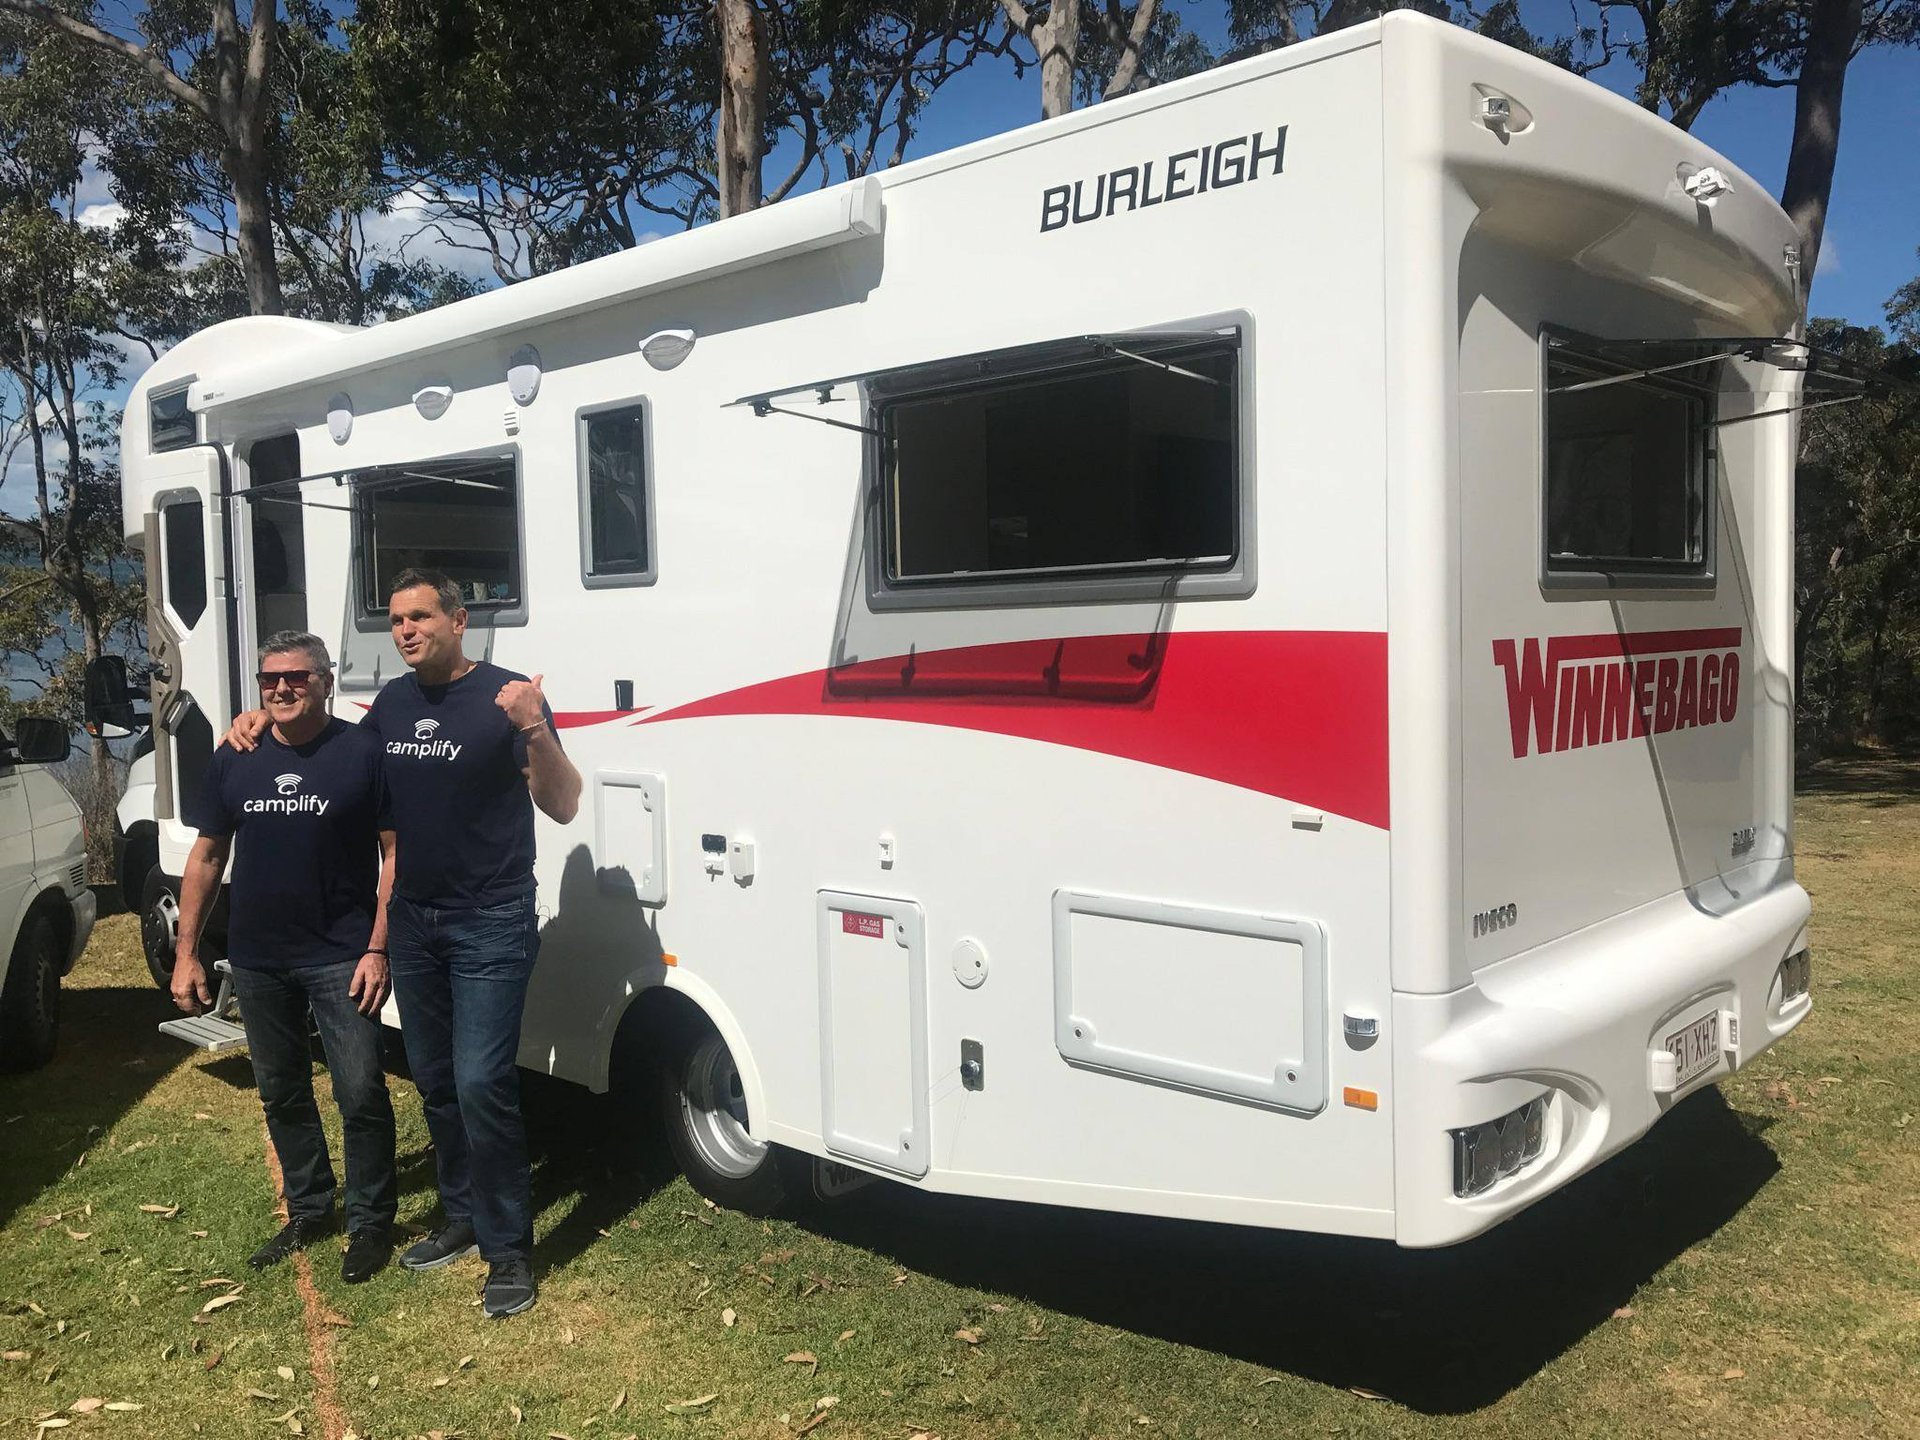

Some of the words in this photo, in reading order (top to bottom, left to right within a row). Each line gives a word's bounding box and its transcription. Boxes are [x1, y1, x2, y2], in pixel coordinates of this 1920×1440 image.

[1040, 124, 1289, 233] BURLEIGH
[1492, 627, 1742, 759] WINNEBAGO
[386, 739, 462, 761] camplify
[243, 794, 329, 816] camplify
[859, 925, 881, 934] STORAGE
[869, 919, 880, 927] GAS
[1473, 903, 1517, 938] IVECO
